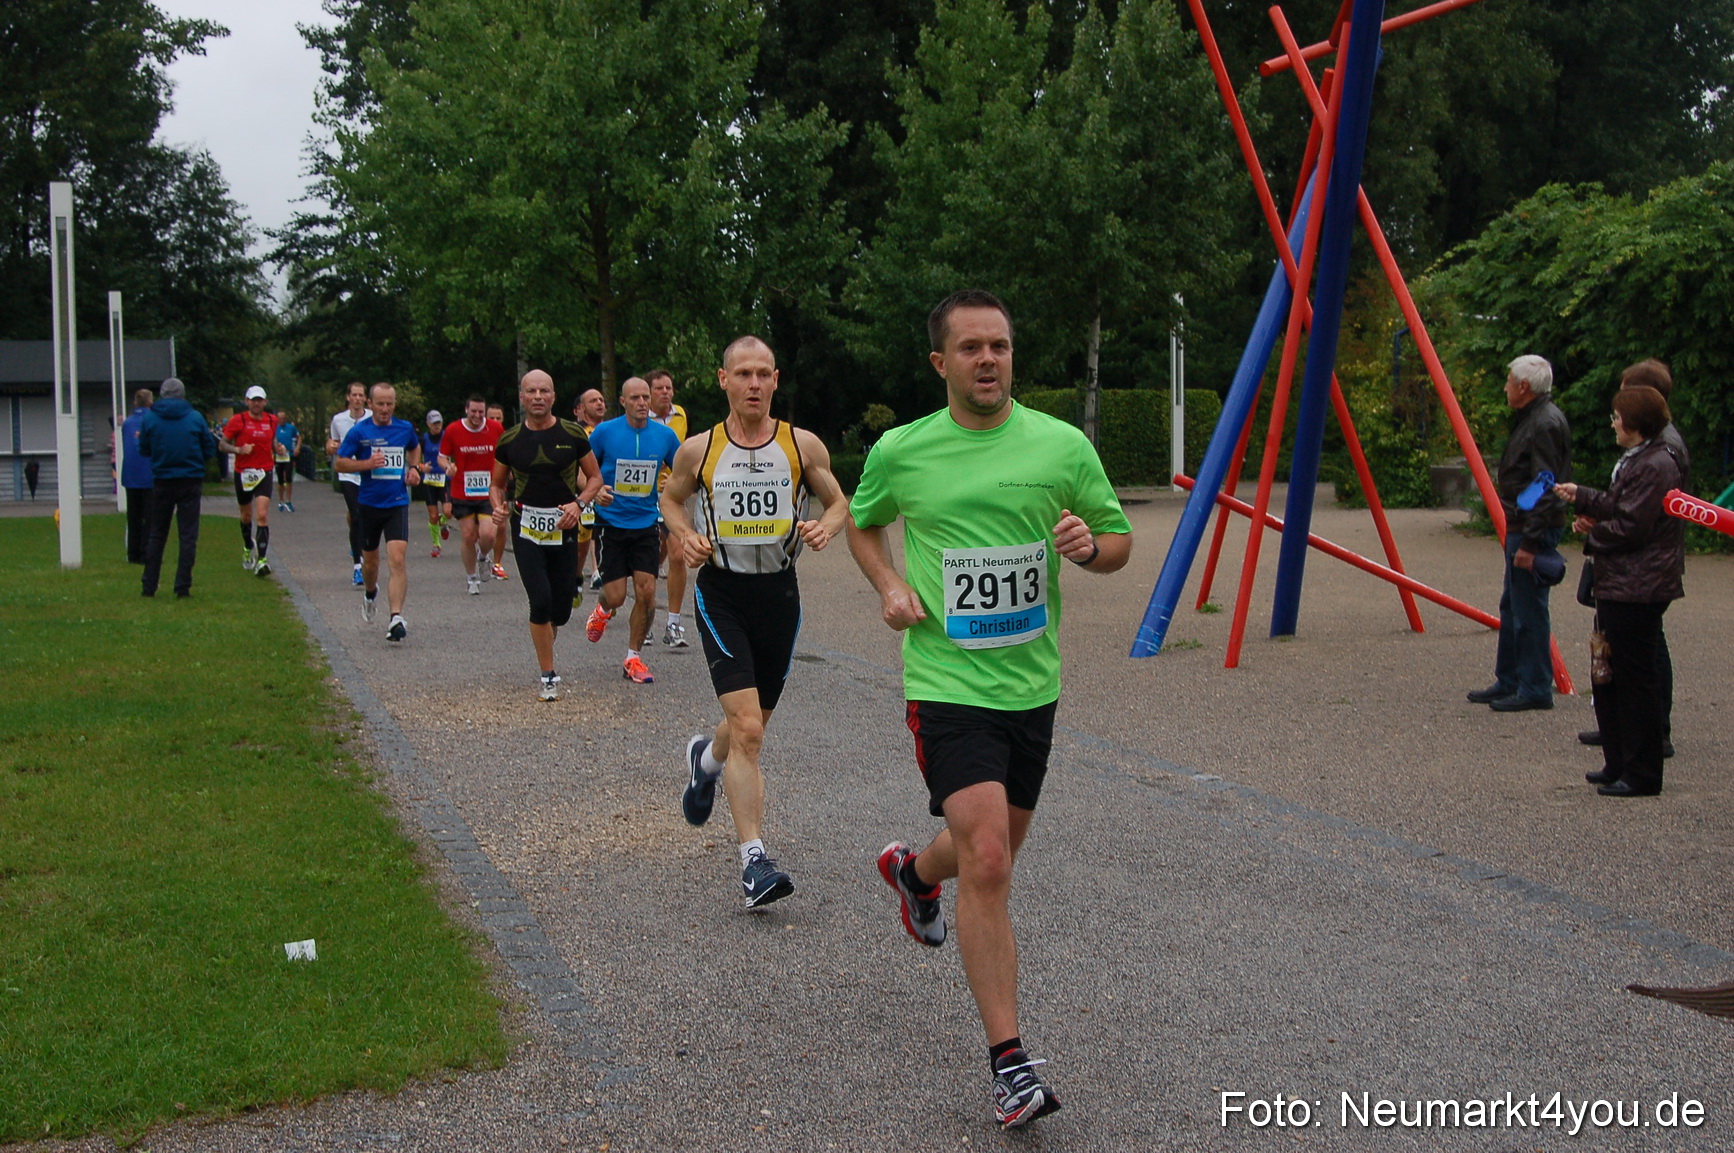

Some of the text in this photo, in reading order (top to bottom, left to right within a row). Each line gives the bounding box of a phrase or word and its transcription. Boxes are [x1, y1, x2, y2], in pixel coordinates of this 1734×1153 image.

[731, 461, 774, 469] BROOKS
[467, 477, 488, 488] 2381
[623, 469, 648, 483] 241
[715, 480, 779, 488] PARTL Neumarkt
[730, 490, 778, 517] 369
[529, 516, 556, 532] 368
[733, 523, 775, 535] Manfred
[944, 554, 1033, 568] PARTL Neumarkt
[955, 567, 1040, 610] 2913
[969, 616, 1031, 635] Christian
